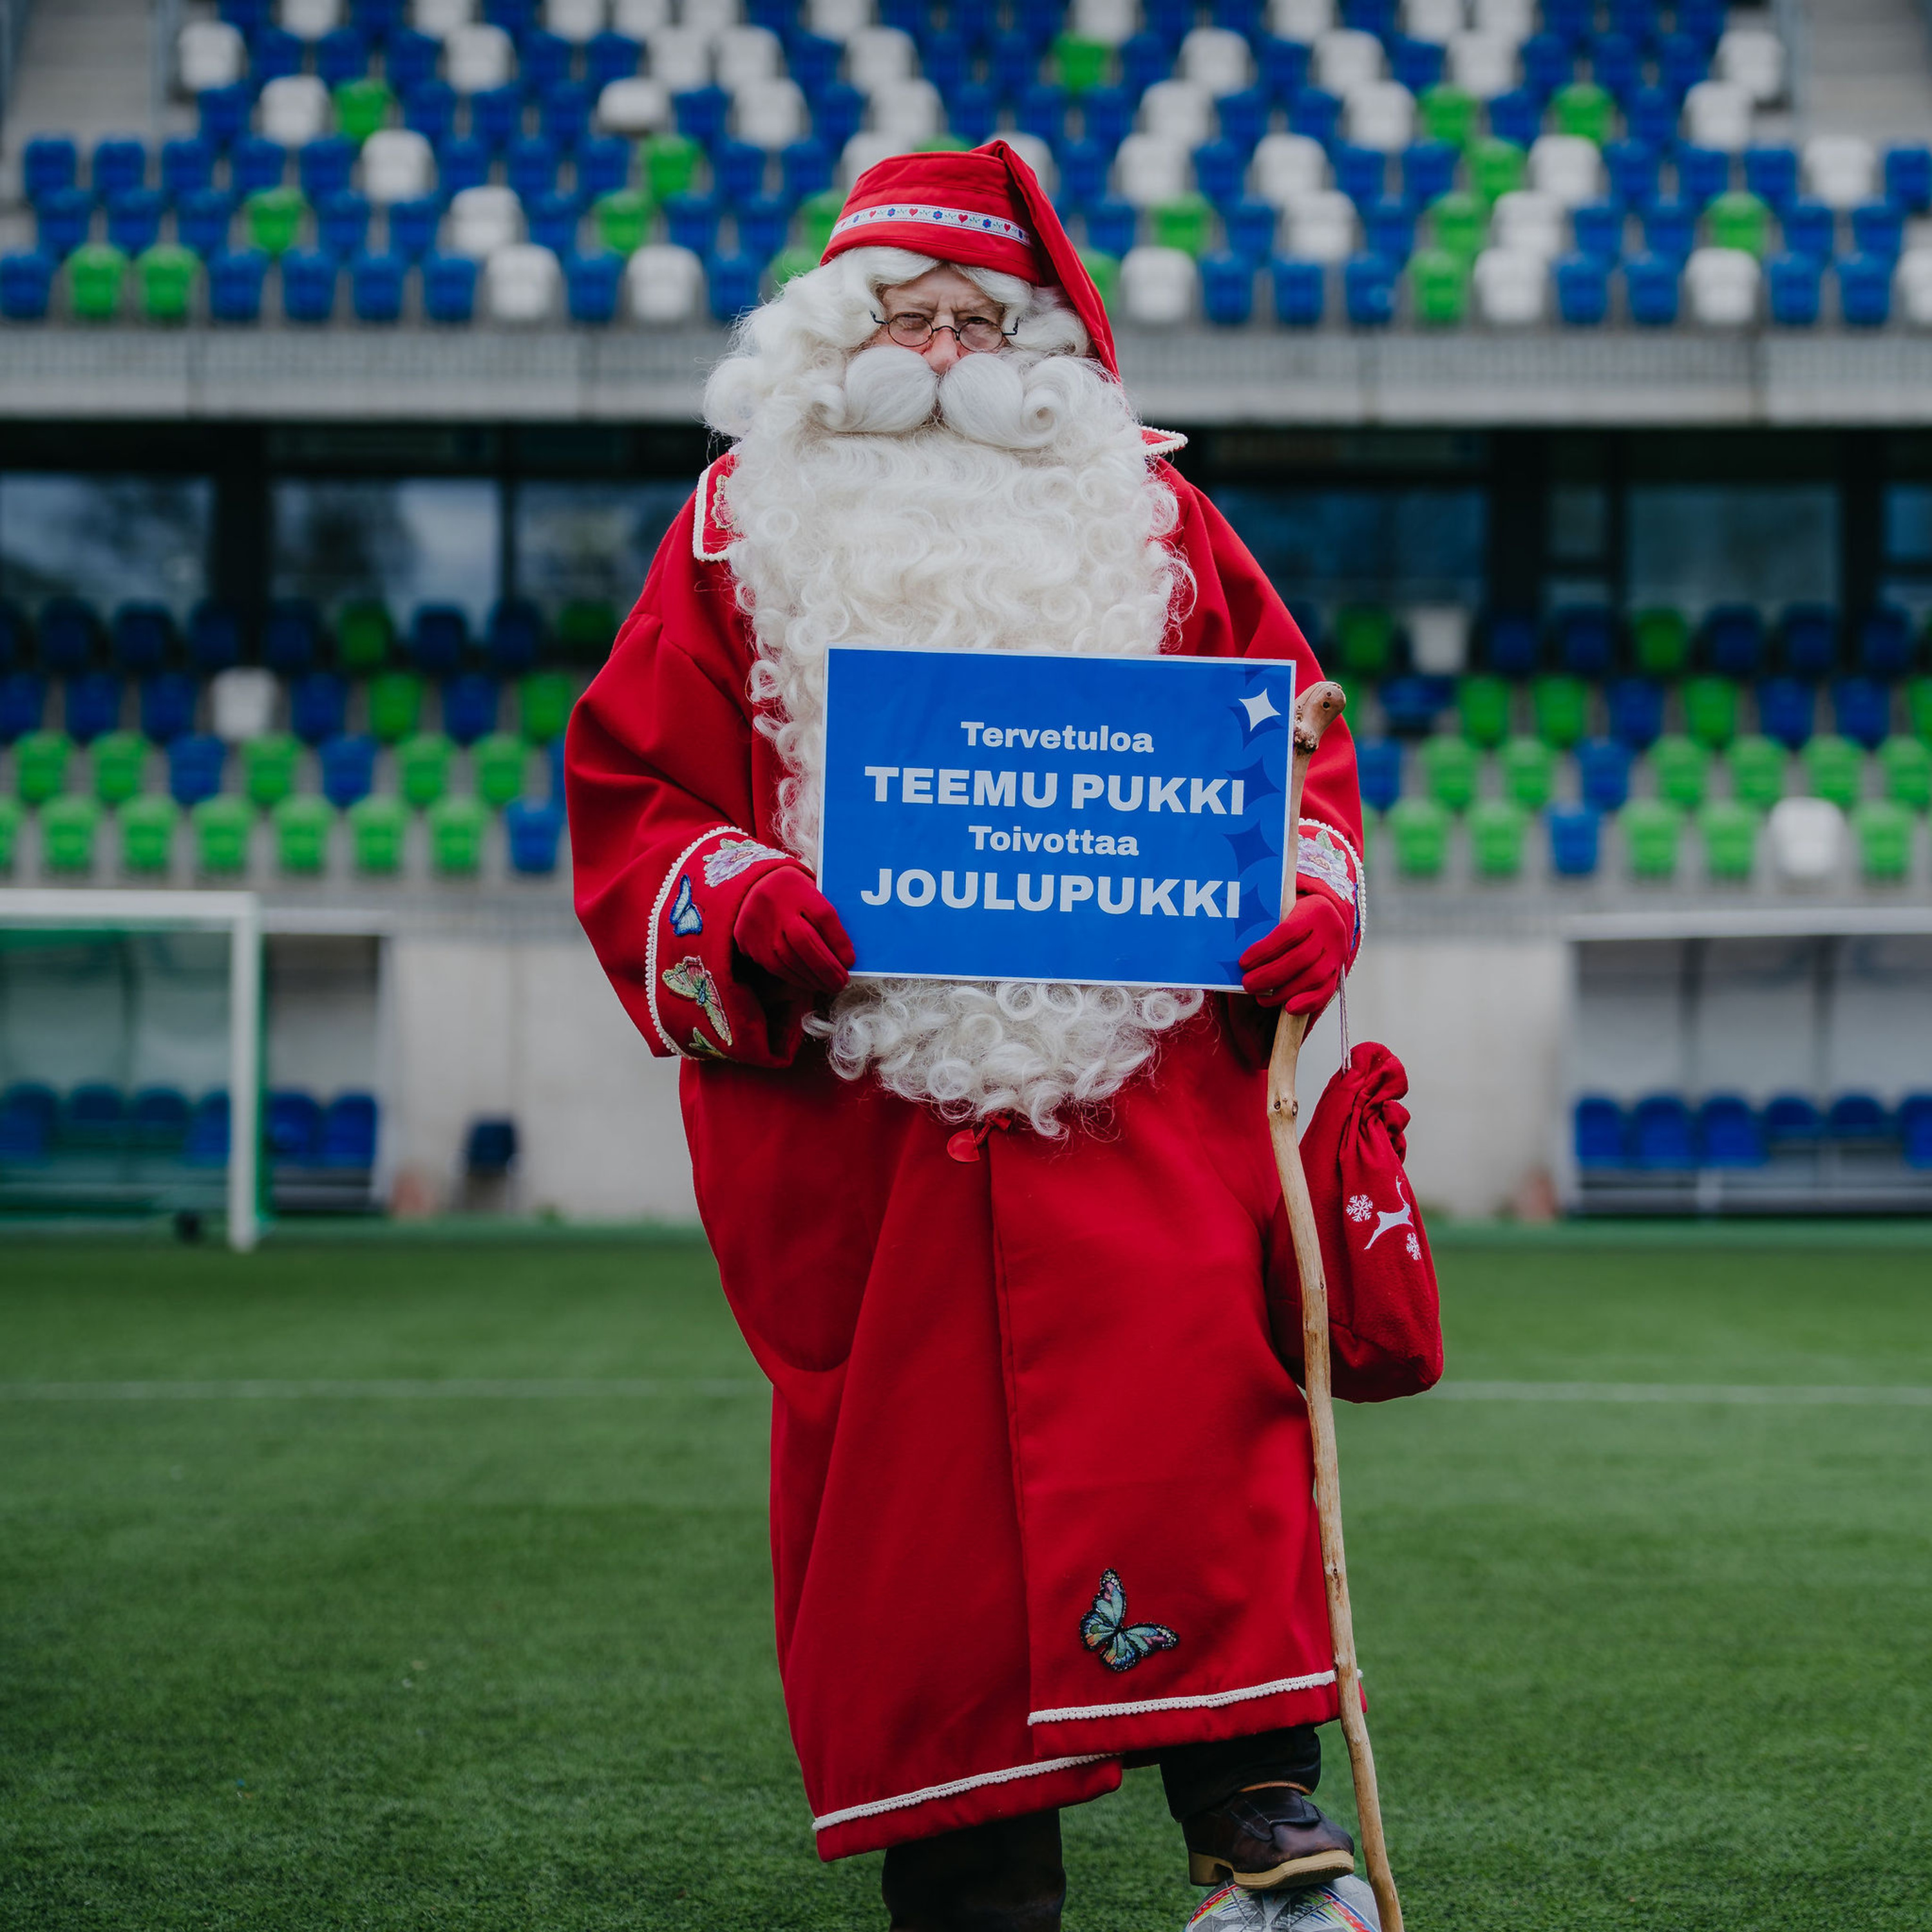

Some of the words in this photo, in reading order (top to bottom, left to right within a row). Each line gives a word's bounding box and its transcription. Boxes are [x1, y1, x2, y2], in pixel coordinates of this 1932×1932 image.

[961, 722, 1154, 752] Tervetuloa
[865, 766, 1057, 808] TEEMU
[1072, 774, 1244, 815] PUKKI
[969, 826, 1139, 856] Toivottaa
[861, 869, 1240, 918] JOULUPUKKI
